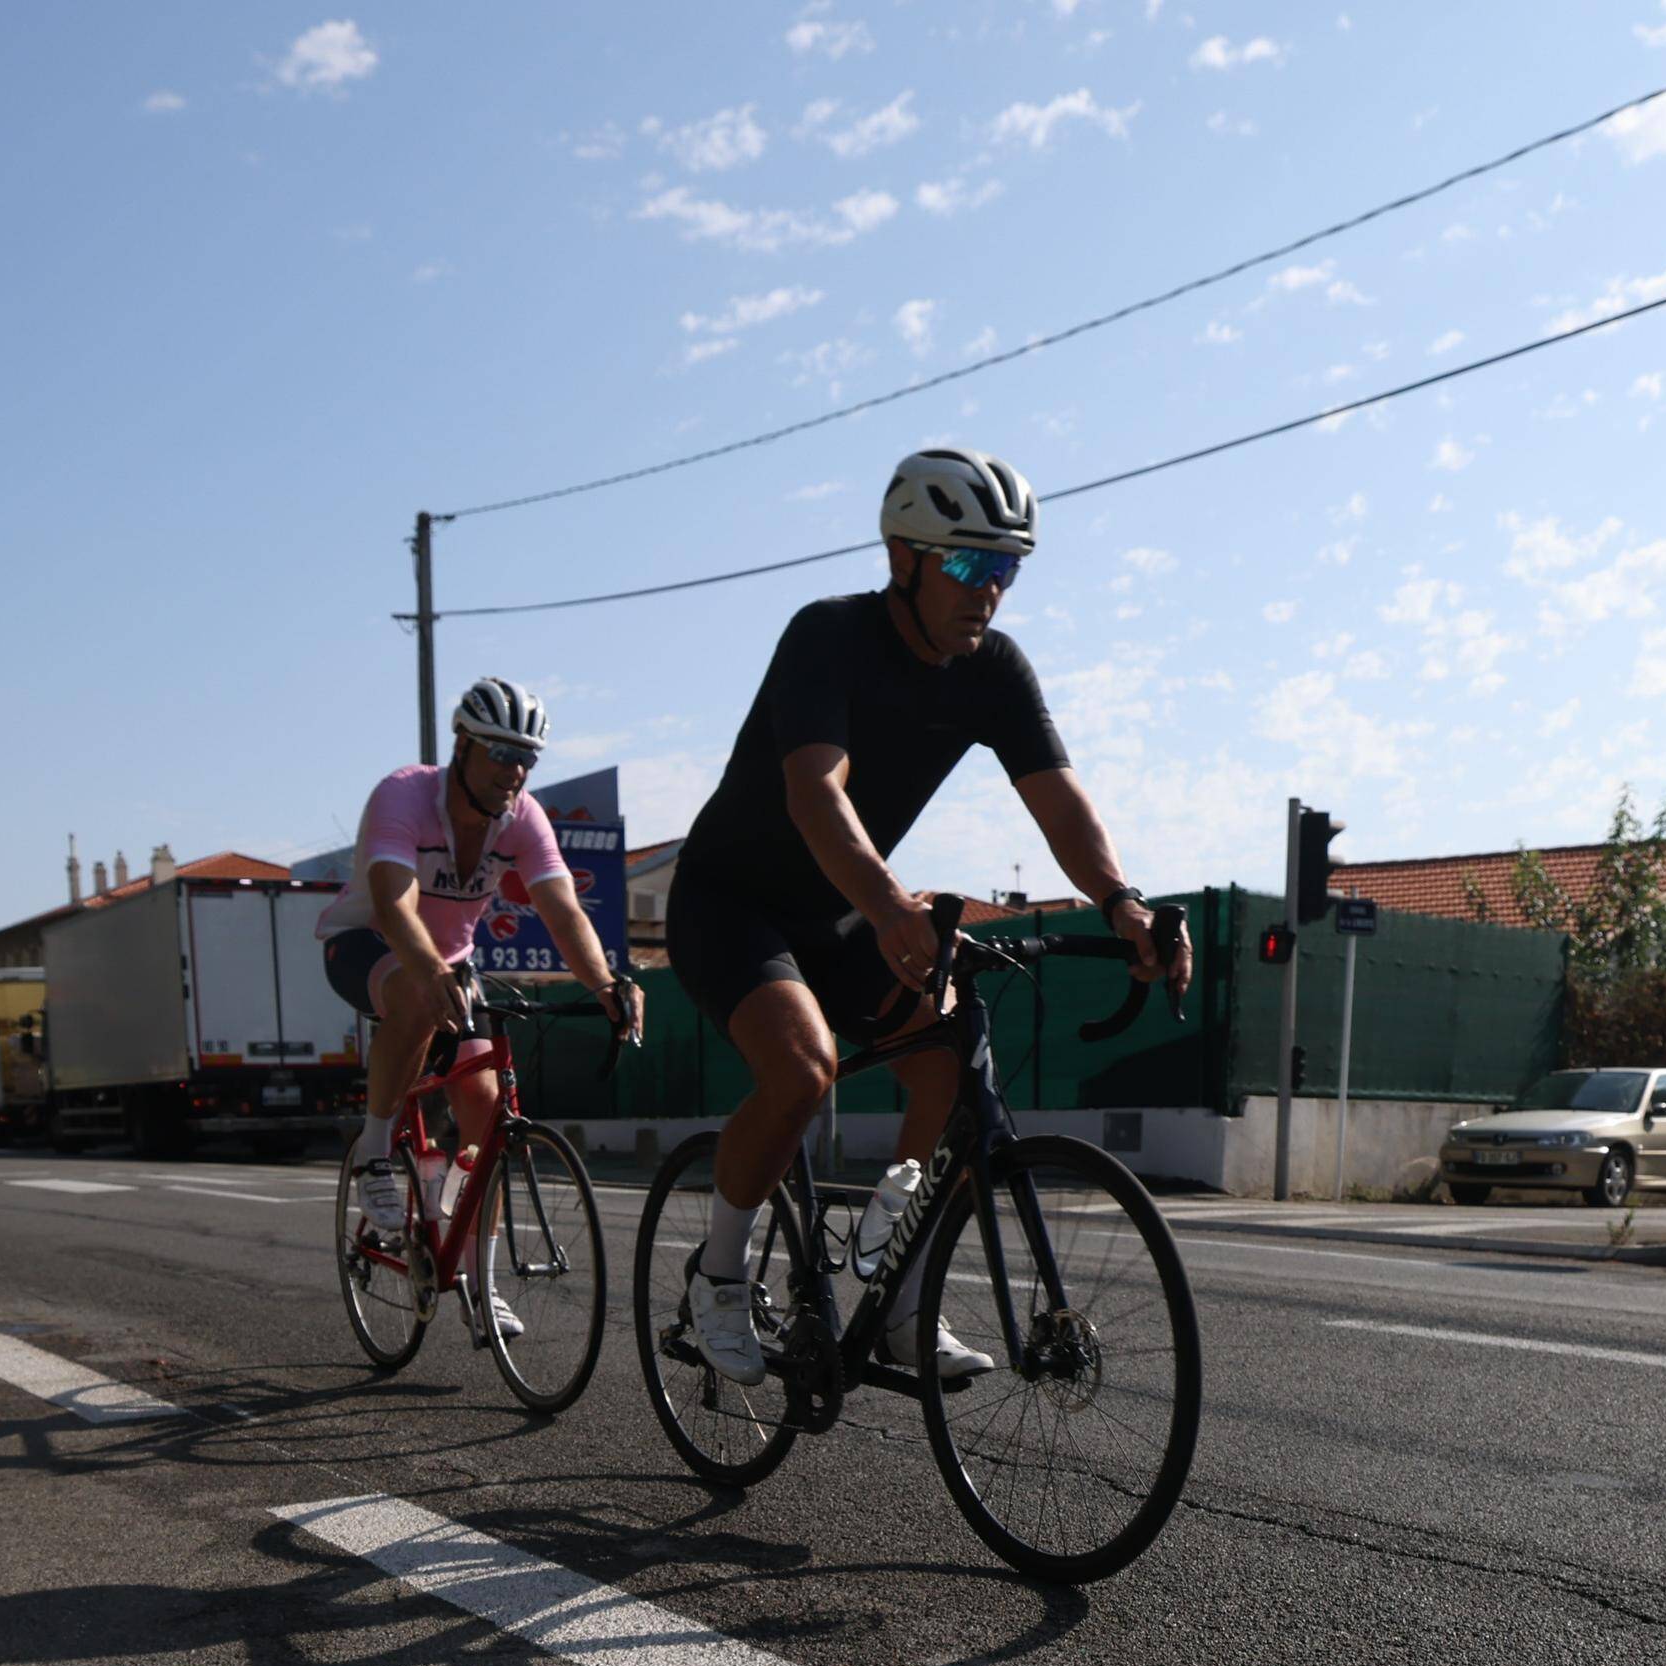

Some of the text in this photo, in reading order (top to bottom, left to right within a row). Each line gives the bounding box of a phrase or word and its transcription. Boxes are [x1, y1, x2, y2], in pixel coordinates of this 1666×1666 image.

[560, 829, 619, 851] TURBO
[491, 946, 519, 970] 93
[525, 947, 552, 970] 33
